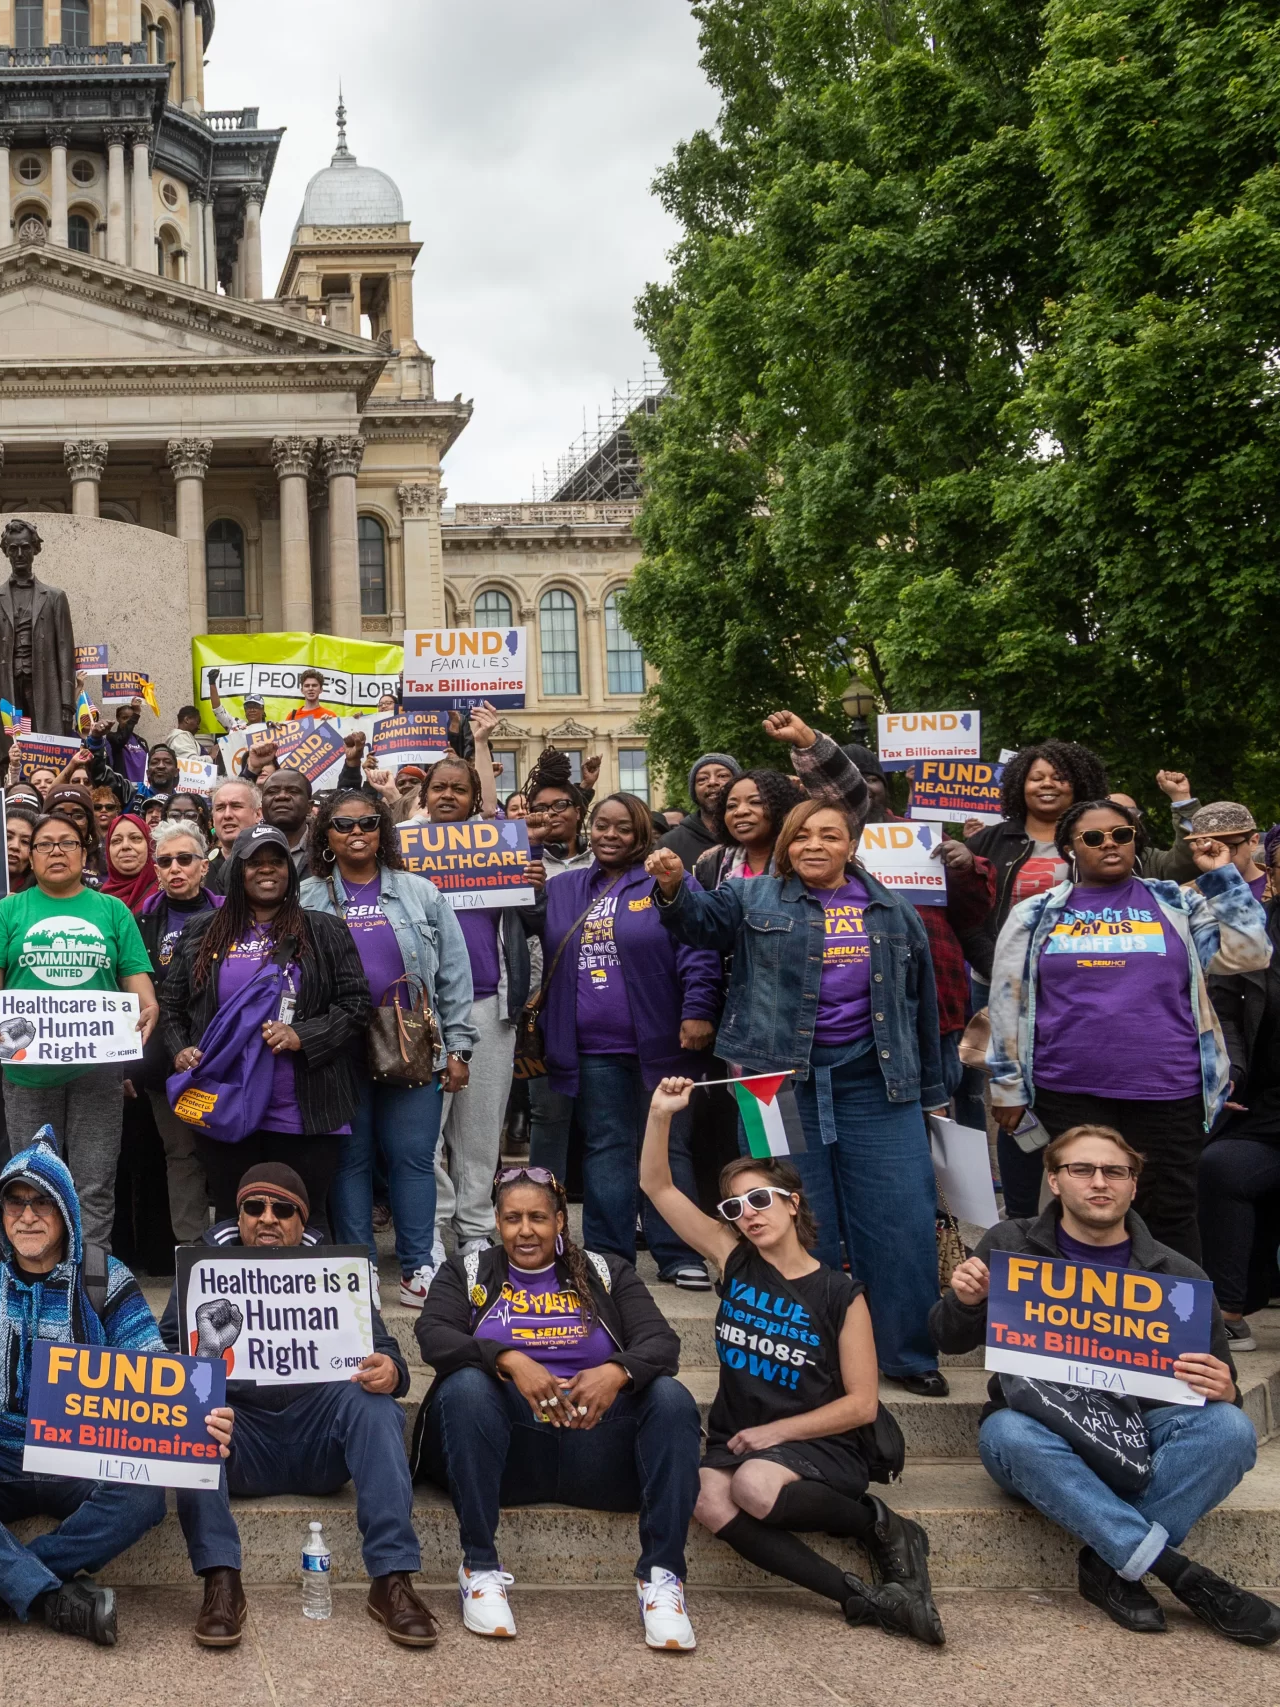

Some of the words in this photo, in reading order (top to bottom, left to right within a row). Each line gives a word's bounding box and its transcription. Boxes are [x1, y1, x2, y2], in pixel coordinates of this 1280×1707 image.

[415, 631, 503, 657] FUND
[430, 656, 510, 673] FAMILIES
[106, 672, 140, 683] FUND
[219, 672, 245, 688] HE
[406, 680, 433, 693] Tax
[438, 677, 523, 692] Billionaires
[380, 716, 407, 730] FUND
[414, 714, 438, 724] OUR
[886, 714, 958, 733] FUND
[373, 726, 447, 743] COMMUNITIES
[389, 738, 448, 749] Billionaires
[22, 752, 67, 765] FAMILIES
[298, 742, 333, 774] OUSING
[881, 748, 902, 759] Tax
[905, 746, 977, 758] Billionaires
[922, 762, 992, 784] FUND
[914, 782, 1001, 798] HEALTHCAR
[914, 795, 936, 806] Tax
[939, 797, 1002, 812] Billionaire
[399, 823, 499, 854] FUND
[430, 871, 529, 889] Billionaires
[1071, 921, 1102, 936] PAY
[1108, 922, 1133, 936] US
[827, 946, 856, 956] SEIU
[1058, 934, 1113, 951] STAFF
[1120, 935, 1148, 951] US
[18, 952, 111, 969] COMMUNITIES
[46, 968, 83, 978] UNITED
[2, 996, 97, 1015] Healthcare
[103, 996, 116, 1012] is
[121, 1000, 132, 1012] a
[38, 1018, 115, 1039] Human
[38, 1042, 97, 1063] Right
[178, 1106, 189, 1115] Pay
[181, 1096, 205, 1109] Protect
[200, 1267, 316, 1295] Healthcare
[323, 1267, 341, 1294] is
[347, 1272, 360, 1293] a
[1007, 1256, 1164, 1313] FUND
[729, 1278, 810, 1327] VALUE
[245, 1299, 340, 1331] Human
[722, 1299, 821, 1347] Therapists
[1024, 1300, 1170, 1344] HOUSING
[537, 1327, 568, 1337] SEIU
[248, 1338, 320, 1376] Right
[991, 1322, 1037, 1349] Tax
[1043, 1331, 1179, 1373] Billionair
[47, 1346, 186, 1397] FUND
[714, 1340, 800, 1391] NOW!!
[1066, 1364, 1126, 1391] ILRA
[64, 1393, 188, 1428] SENIORS
[30, 1419, 72, 1444] Tax
[78, 1424, 218, 1459] Billionaires
[98, 1458, 151, 1482] ILRA
